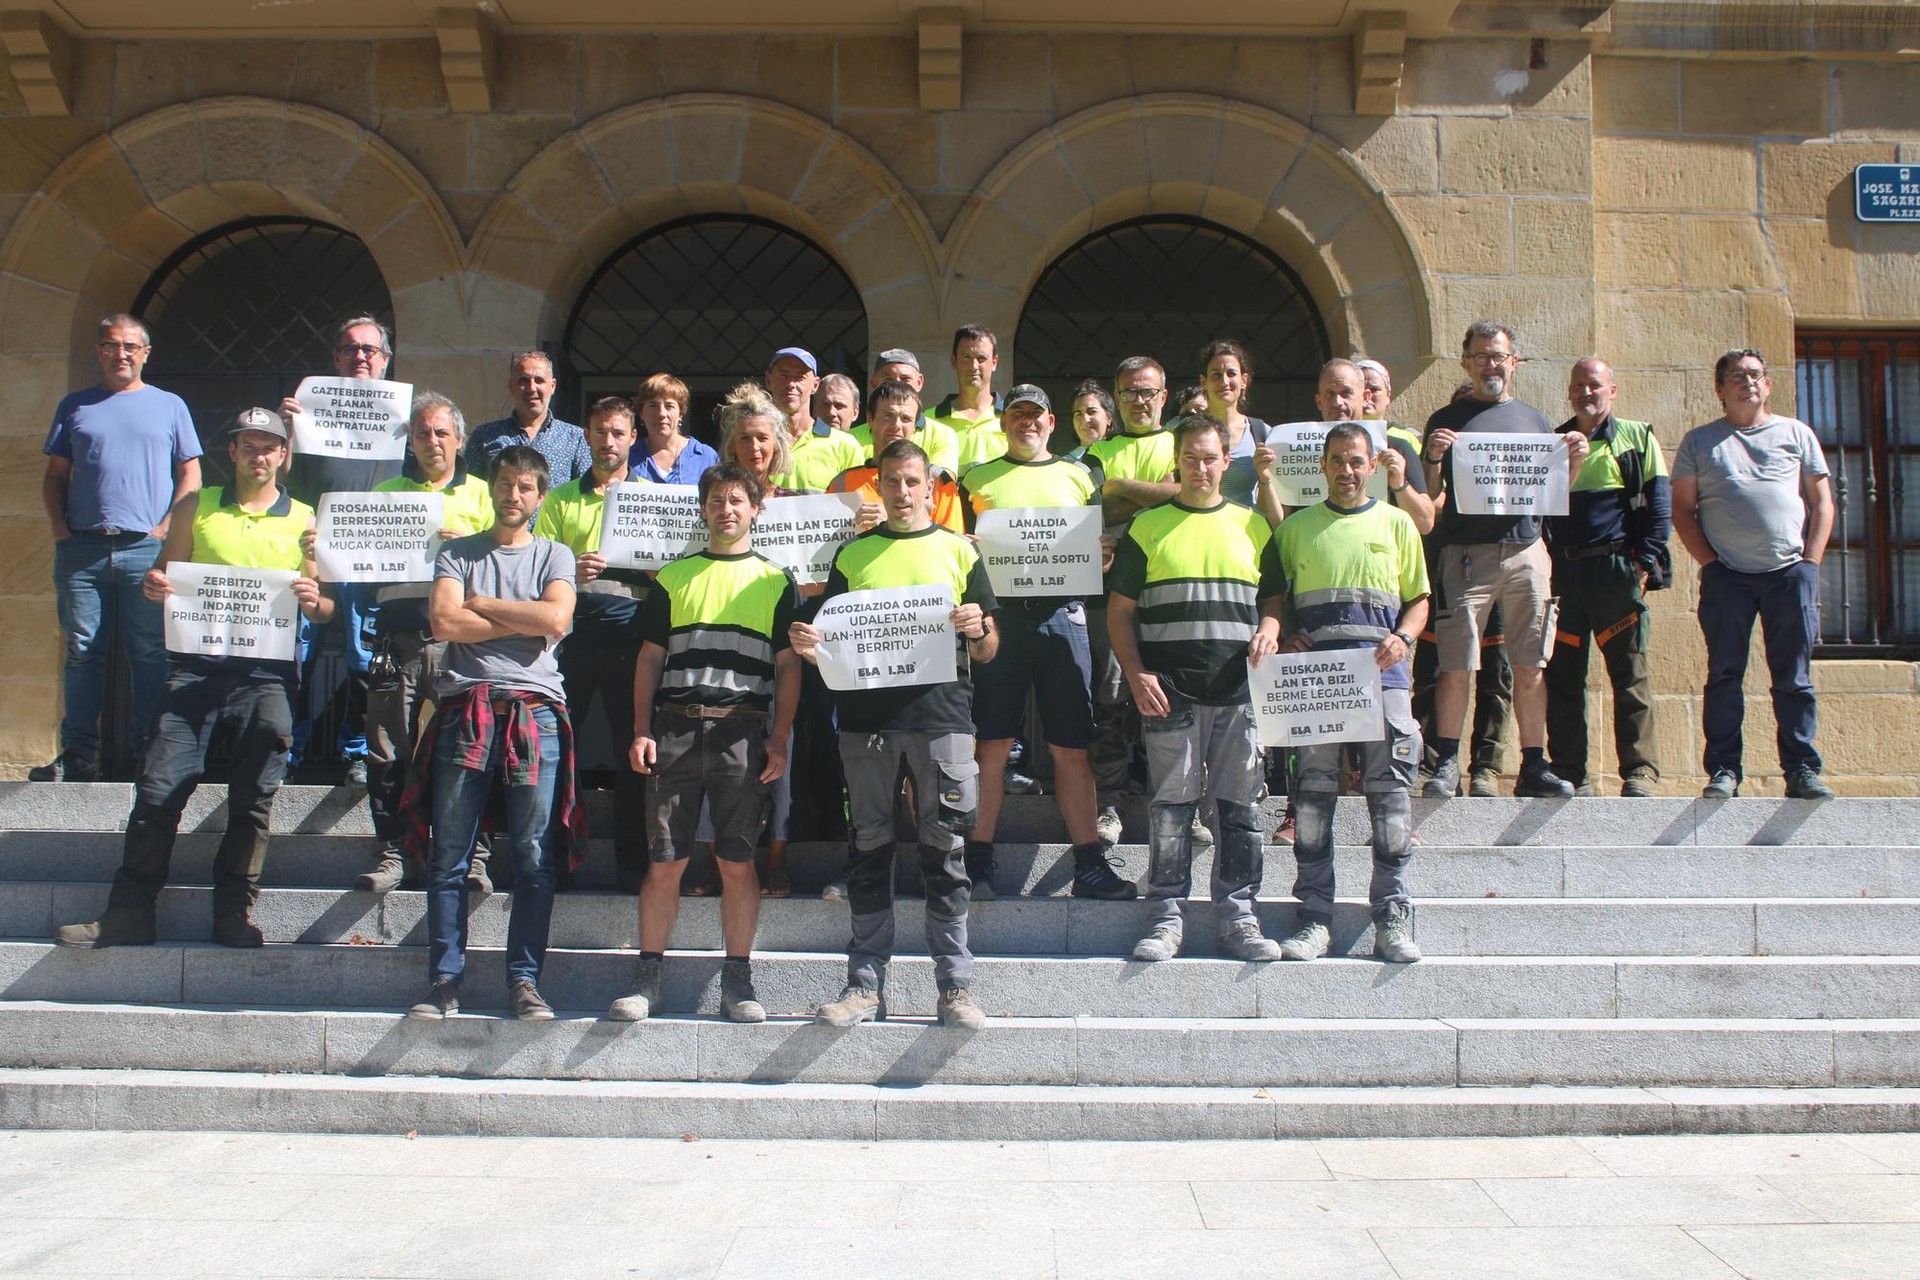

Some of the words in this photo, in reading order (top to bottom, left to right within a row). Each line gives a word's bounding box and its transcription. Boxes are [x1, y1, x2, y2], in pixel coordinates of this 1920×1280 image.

[1862, 184, 1893, 194] JOSE
[311, 386, 395, 400] GAZTEBERRITZE
[331, 399, 374, 409] PLANAK
[314, 409, 333, 418] ETA
[335, 410, 389, 421] ERRELEBO
[315, 420, 386, 432] KONTRATUAK
[1297, 432, 1326, 441] EUSK
[325, 440, 343, 448] ELA
[1289, 444, 1311, 452] LAN
[1468, 443, 1553, 452] GAZTEBERRITZE
[1282, 455, 1319, 464] BERME
[1489, 454, 1532, 463] PLANAK
[1473, 465, 1492, 474] ETA
[1495, 466, 1549, 475] ERRELEBO
[1475, 477, 1546, 486] KONTRATUAK
[330, 504, 428, 513] EROSAHALMENA
[333, 516, 426, 525] BERRESKURATU
[617, 516, 638, 526] ETA
[641, 517, 707, 529] MADRILEKO
[1009, 518, 1067, 528] LANALDIA
[749, 522, 792, 535] HEMEN
[796, 520, 820, 531] LAN
[823, 518, 856, 529] EGIN,
[333, 528, 354, 537] ETA
[358, 528, 426, 537] MADRILEKO
[613, 529, 654, 539] MUGAK
[657, 530, 710, 542] GAINDITU
[1021, 530, 1056, 540] JAITSI
[329, 541, 371, 550] MUGAK
[375, 541, 430, 550] GAINDITU
[751, 535, 794, 548] HEMEN
[1028, 543, 1049, 552] ETA
[634, 551, 654, 560] ELA
[989, 555, 1049, 565] ENPLEGUA
[1051, 554, 1090, 564] SORTU
[353, 563, 374, 571] ELA
[204, 576, 262, 588] ZERBITZU
[1014, 577, 1034, 586] ELA
[197, 588, 267, 601] PUBLIKOAK
[203, 601, 260, 613] INDARTU!
[822, 600, 900, 616] NEGOZIAZIOA
[903, 597, 943, 609] ORAIN!
[171, 611, 271, 626] PRIBATIZAZIORIK
[275, 618, 289, 627] EZ
[849, 612, 917, 626] UDALETAN
[824, 623, 945, 642] LAN-HITZARMENAK
[202, 635, 223, 644] ELA
[857, 639, 914, 653] BERRITU!
[858, 667, 880, 677] ELA
[1281, 662, 1346, 675] EUSKARAZ
[1274, 679, 1298, 688] LAN
[1302, 677, 1325, 687] ETA
[1328, 674, 1355, 685] BIZI!
[1267, 690, 1307, 702] BERME
[1311, 686, 1365, 699] LEGALAK
[1262, 699, 1372, 715] EUSKARARENTZAT!
[1291, 725, 1312, 735] ELA
